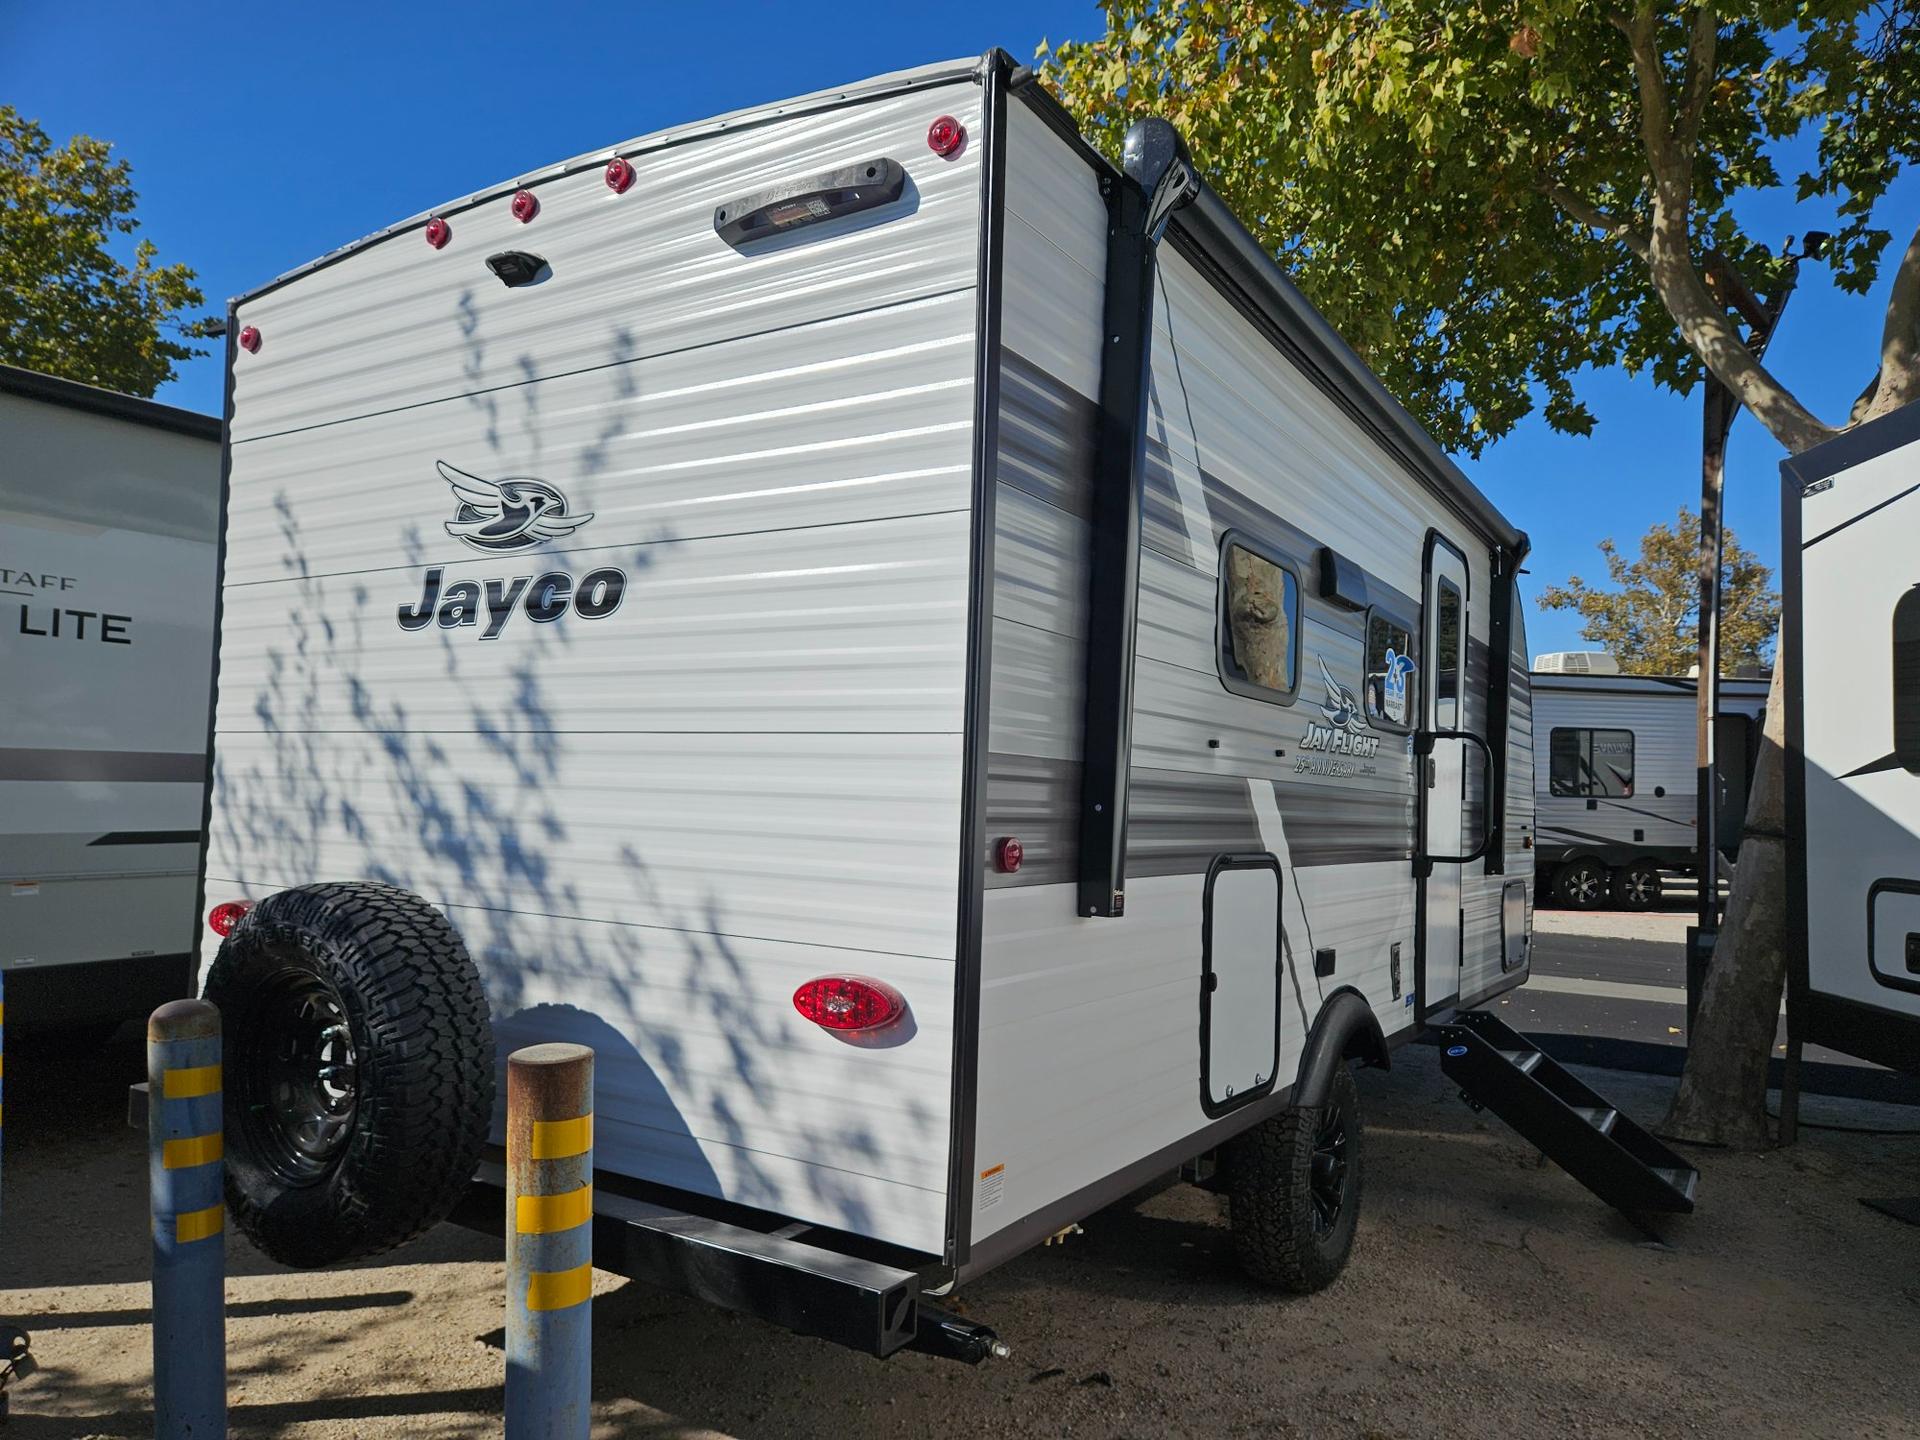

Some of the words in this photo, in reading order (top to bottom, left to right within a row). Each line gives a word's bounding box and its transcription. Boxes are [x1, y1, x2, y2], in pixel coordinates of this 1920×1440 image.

[396, 565, 628, 641] Jayco
[20, 604, 133, 645] LITE
[1299, 720, 1333, 751] JAY
[1330, 727, 1380, 758] FLIGHT
